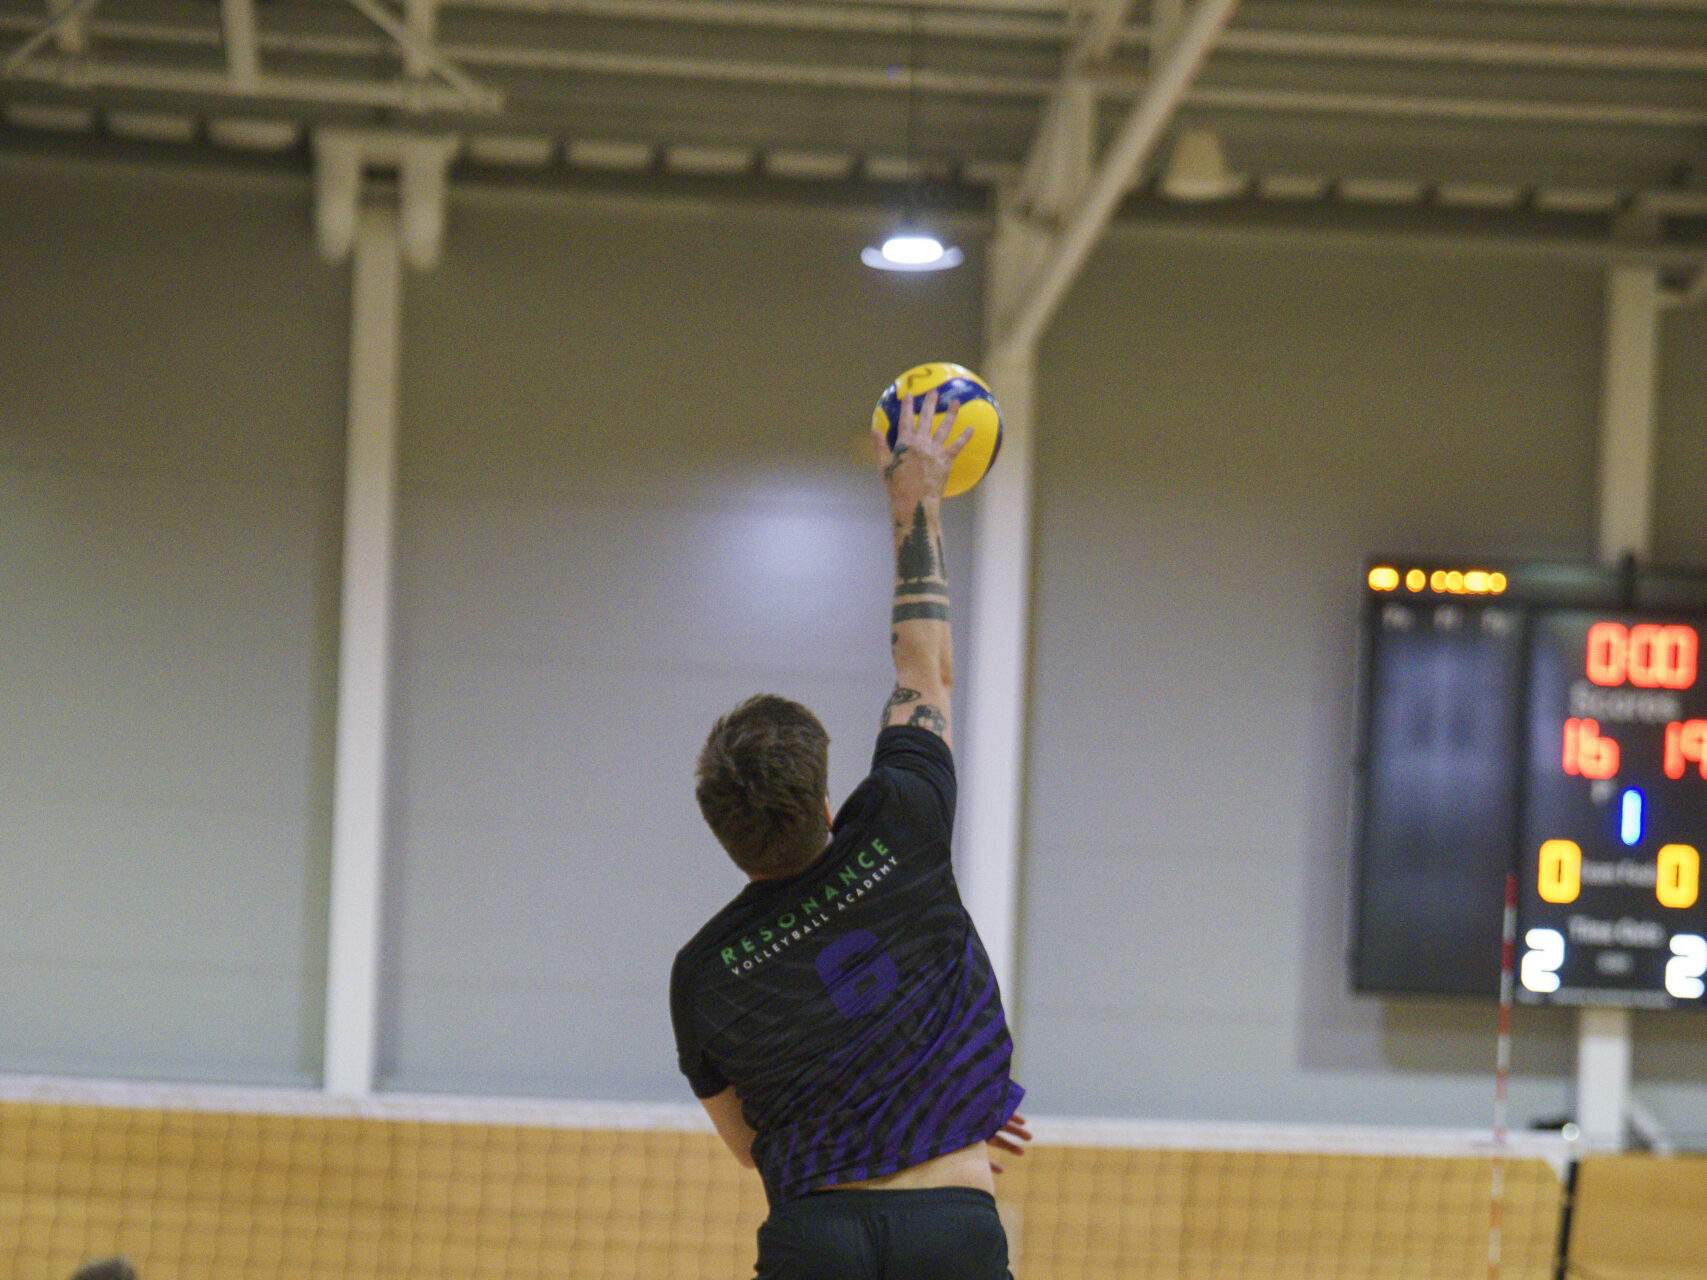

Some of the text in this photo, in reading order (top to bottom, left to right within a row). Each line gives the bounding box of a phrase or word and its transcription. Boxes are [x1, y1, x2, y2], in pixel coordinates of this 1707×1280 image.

[1562, 717, 1620, 780] 16
[720, 838, 888, 965] RESONANCE
[1538, 839, 1582, 904] 0
[1656, 843, 1700, 909] 0
[731, 855, 898, 976] VOLLEYBALL ACADEMY
[1520, 928, 1565, 993] 2
[1665, 933, 1707, 999] 2
